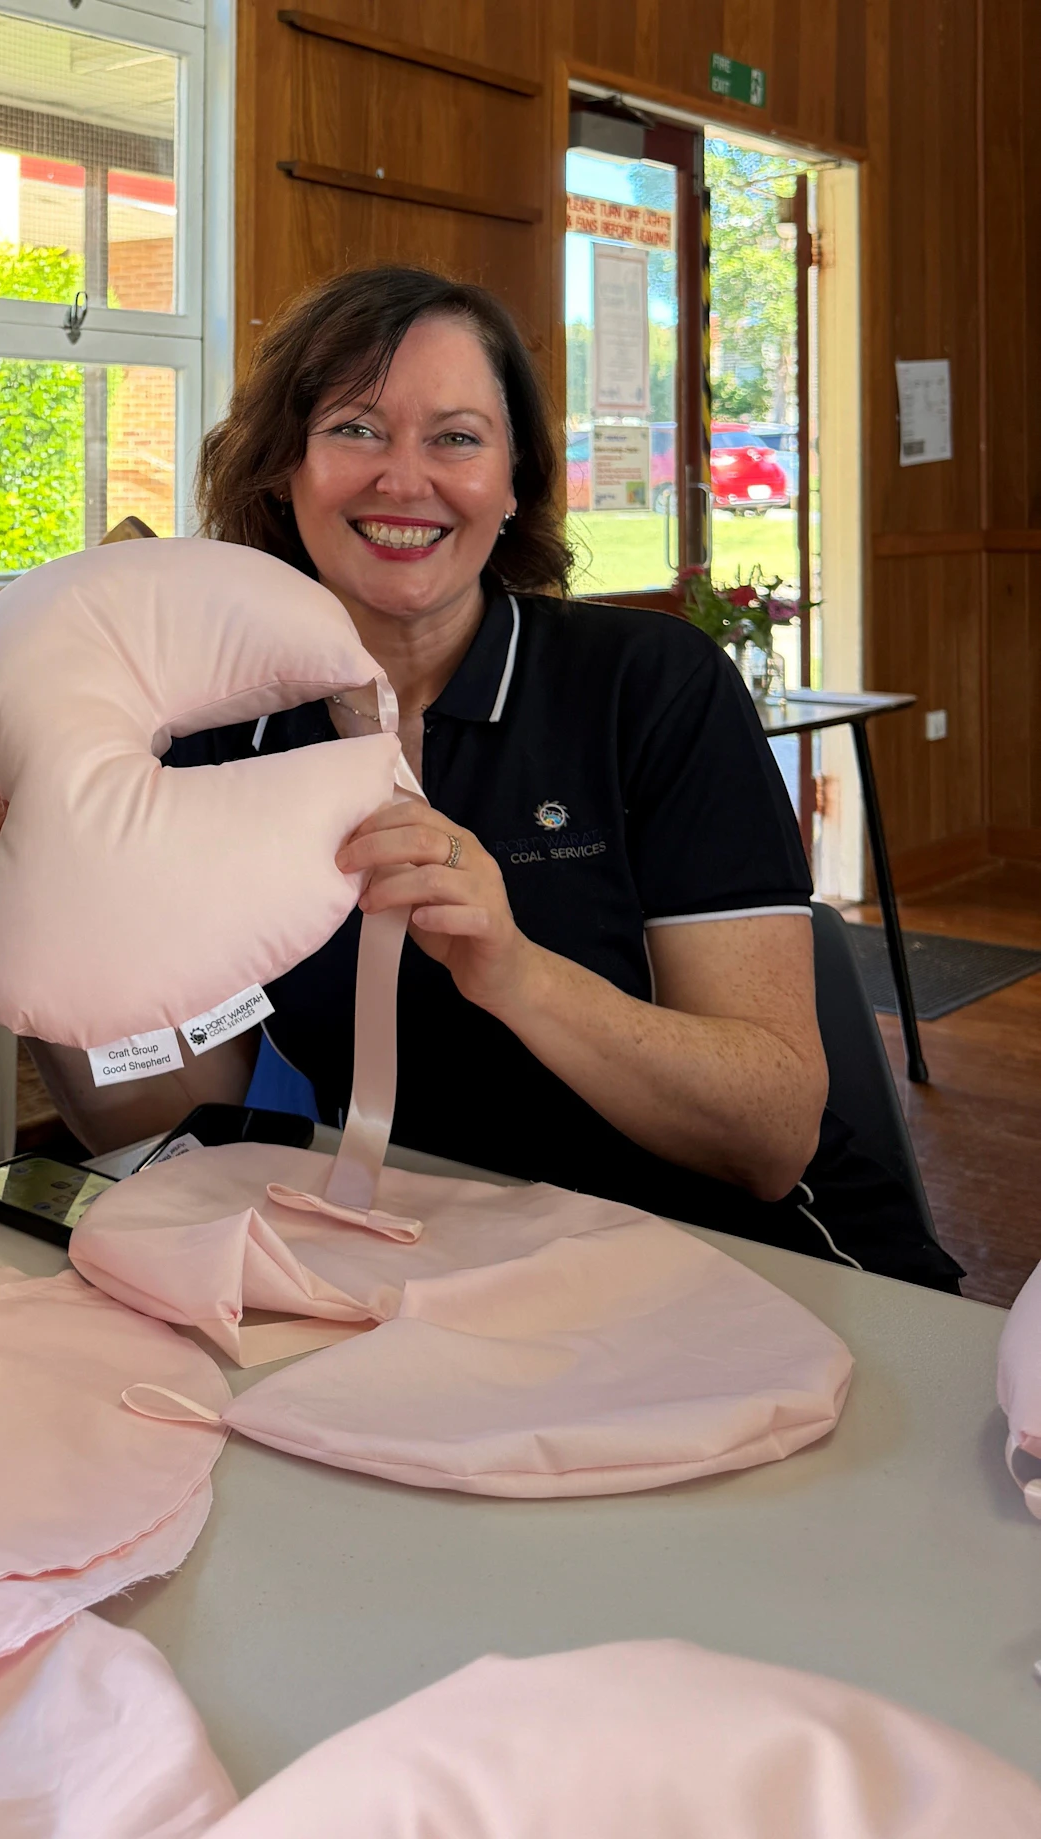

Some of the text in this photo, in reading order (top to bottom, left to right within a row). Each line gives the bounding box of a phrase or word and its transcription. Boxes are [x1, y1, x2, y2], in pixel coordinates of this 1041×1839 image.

[712, 53, 731, 73] FIRE
[711, 76, 730, 95] EXIT
[600, 203, 622, 219] TURN
[624, 207, 641, 222] OFF
[576, 215, 598, 232] FANS
[601, 221, 633, 240] BEFORE
[636, 228, 668, 247] LEAVING
[543, 829, 611, 849] WARAT
[510, 841, 607, 864] COAL SERVICES
[205, 993, 264, 1032] PORT WARATAH
[209, 1008, 256, 1038] COAL SERVICES
[108, 1044, 159, 1060] Craft Group
[102, 1055, 171, 1076] Good Shepherd
